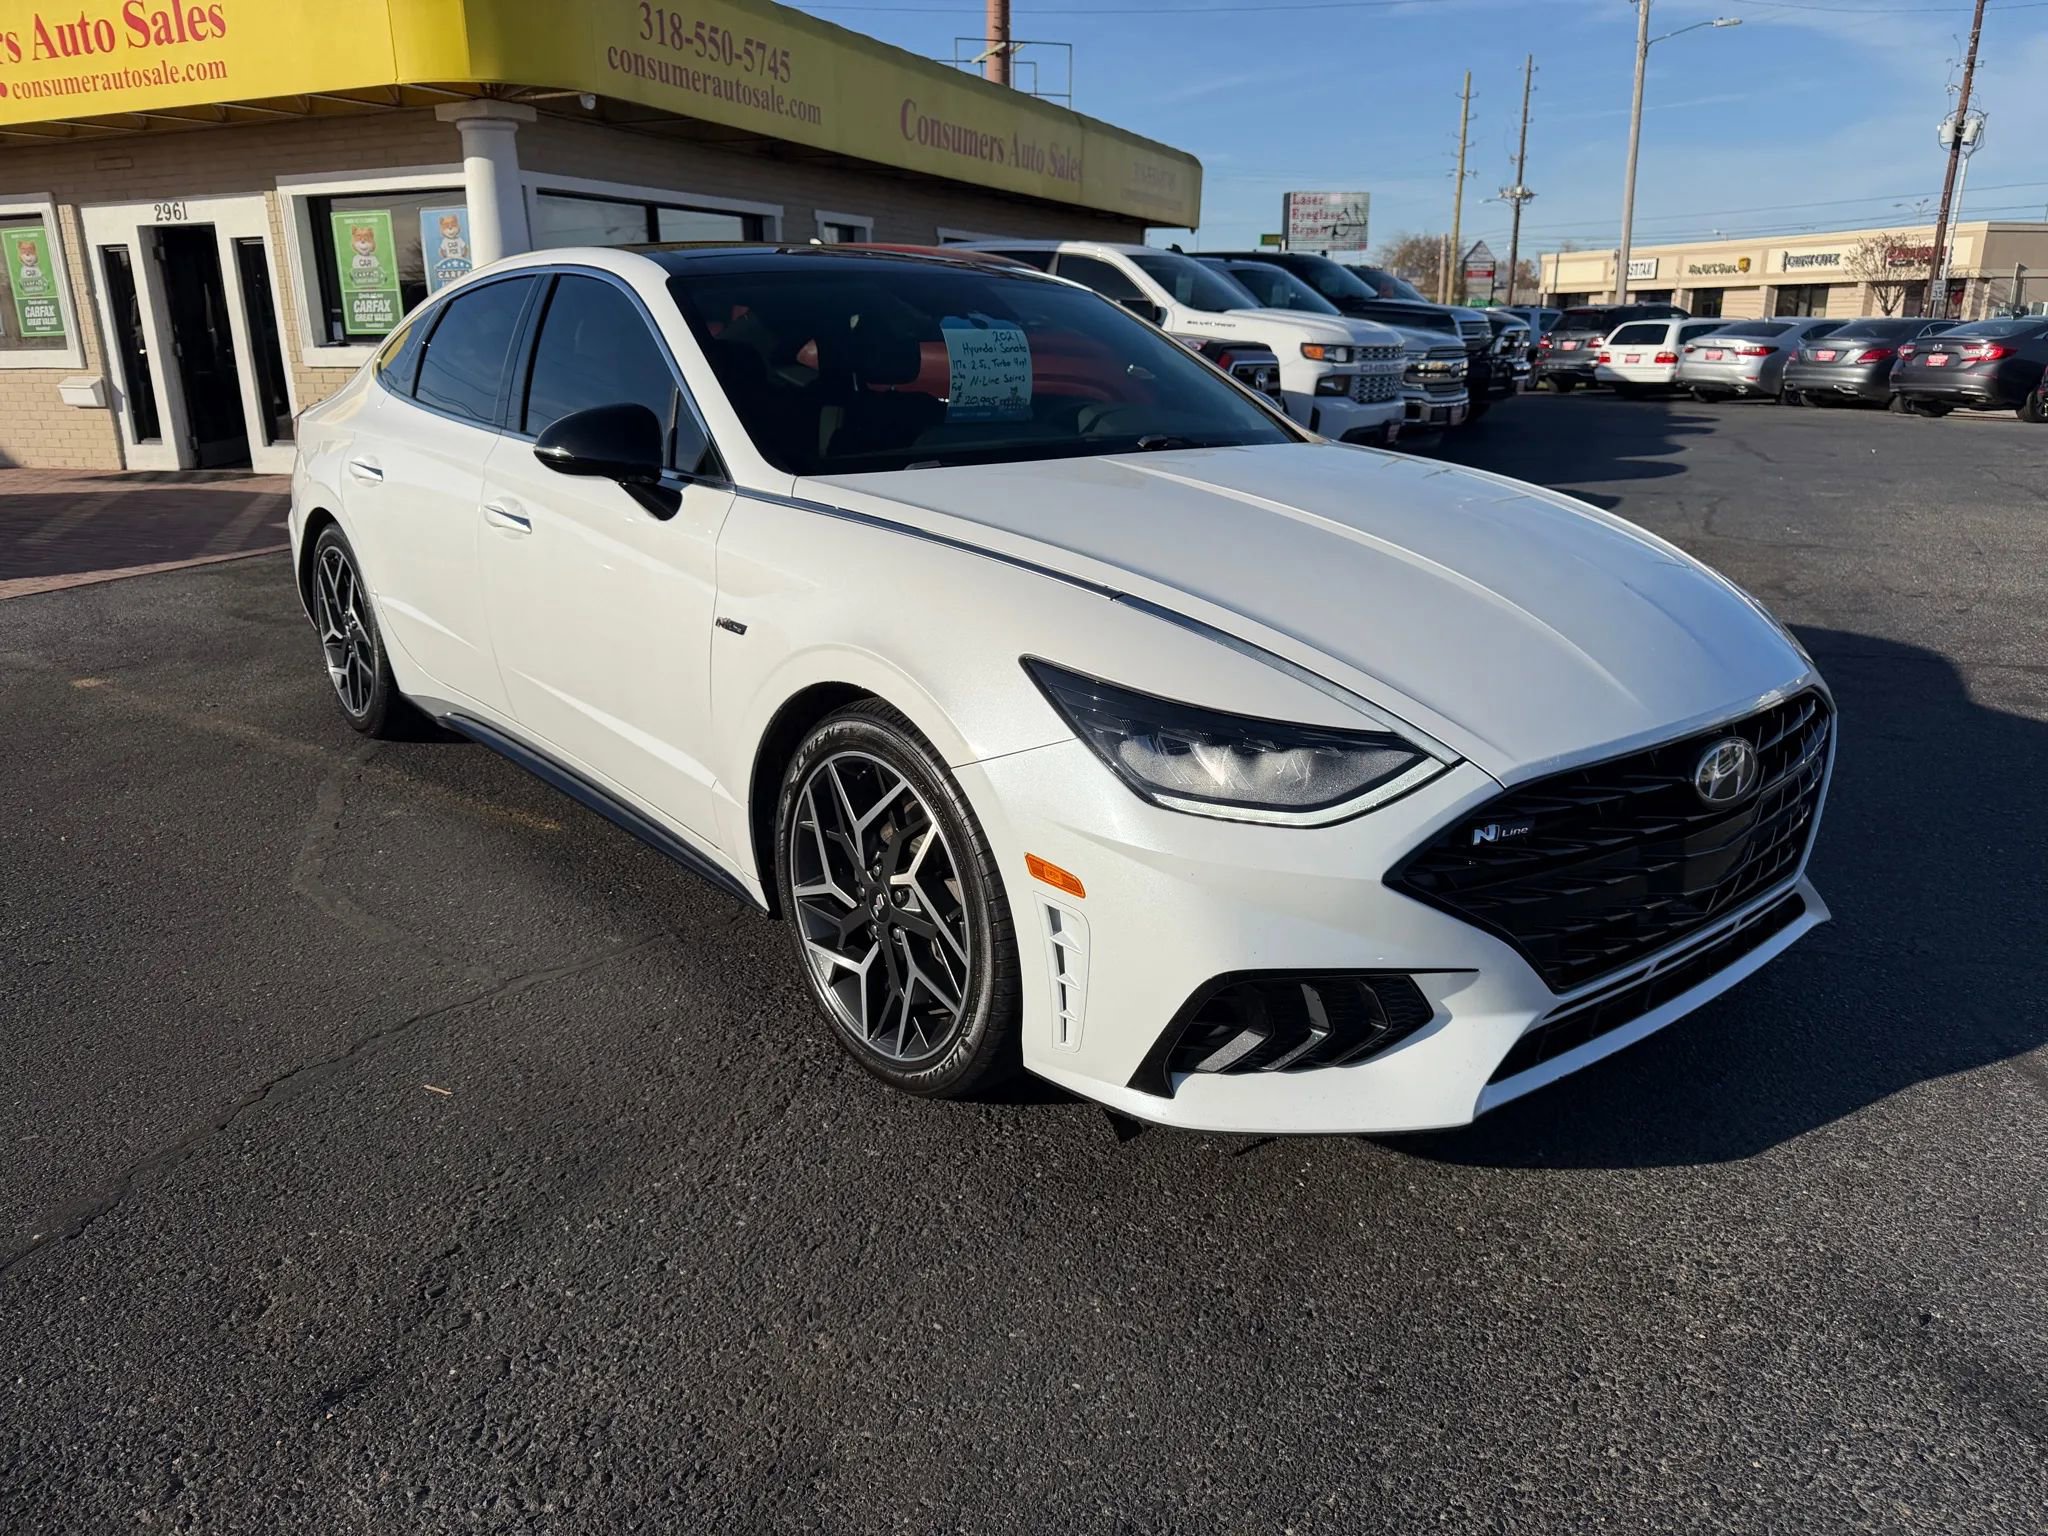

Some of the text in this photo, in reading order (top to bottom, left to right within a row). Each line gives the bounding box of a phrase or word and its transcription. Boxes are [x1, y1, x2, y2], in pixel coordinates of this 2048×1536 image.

[0, 0, 227, 64] s Auto Sales
[639, 1, 791, 84] 318-550-5745
[12, 60, 228, 99] consumerautosale.com
[607, 46, 822, 125] consumerautosale.com
[900, 98, 1005, 162] Consumers
[1007, 131, 1045, 175] Auto
[1048, 142, 1082, 183] Sales
[154, 202, 188, 222] 2961
[25, 305, 55, 317] CARFAX
[353, 300, 391, 313] CARFAX
[1502, 827, 1529, 837] Line
